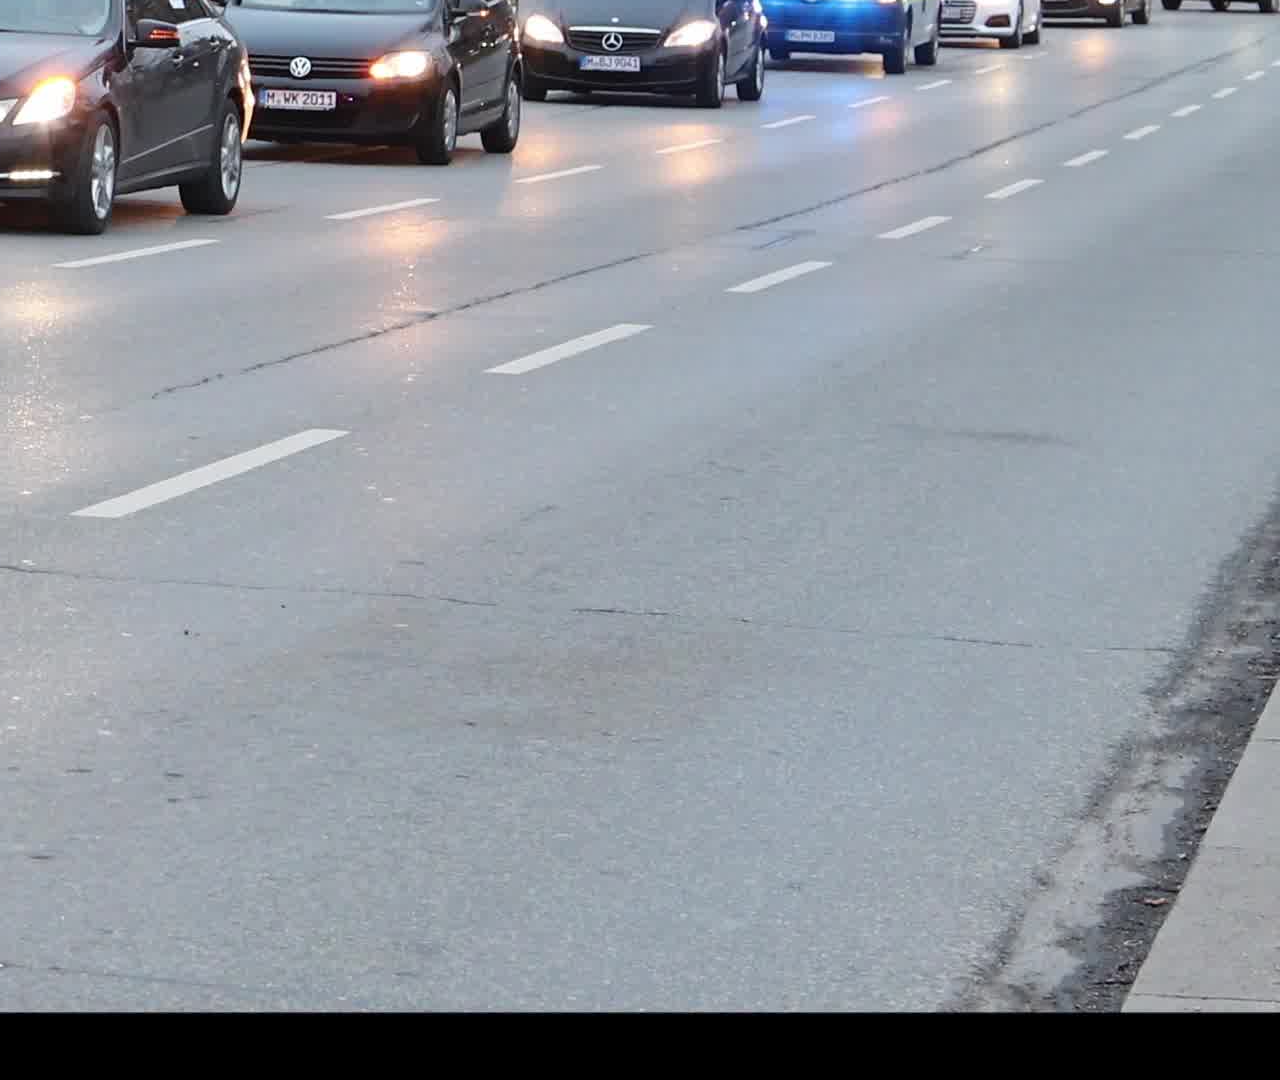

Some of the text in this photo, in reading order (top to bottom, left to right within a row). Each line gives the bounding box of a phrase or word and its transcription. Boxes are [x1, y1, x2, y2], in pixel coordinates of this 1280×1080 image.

[267, 92, 334, 106] M WK 2011
